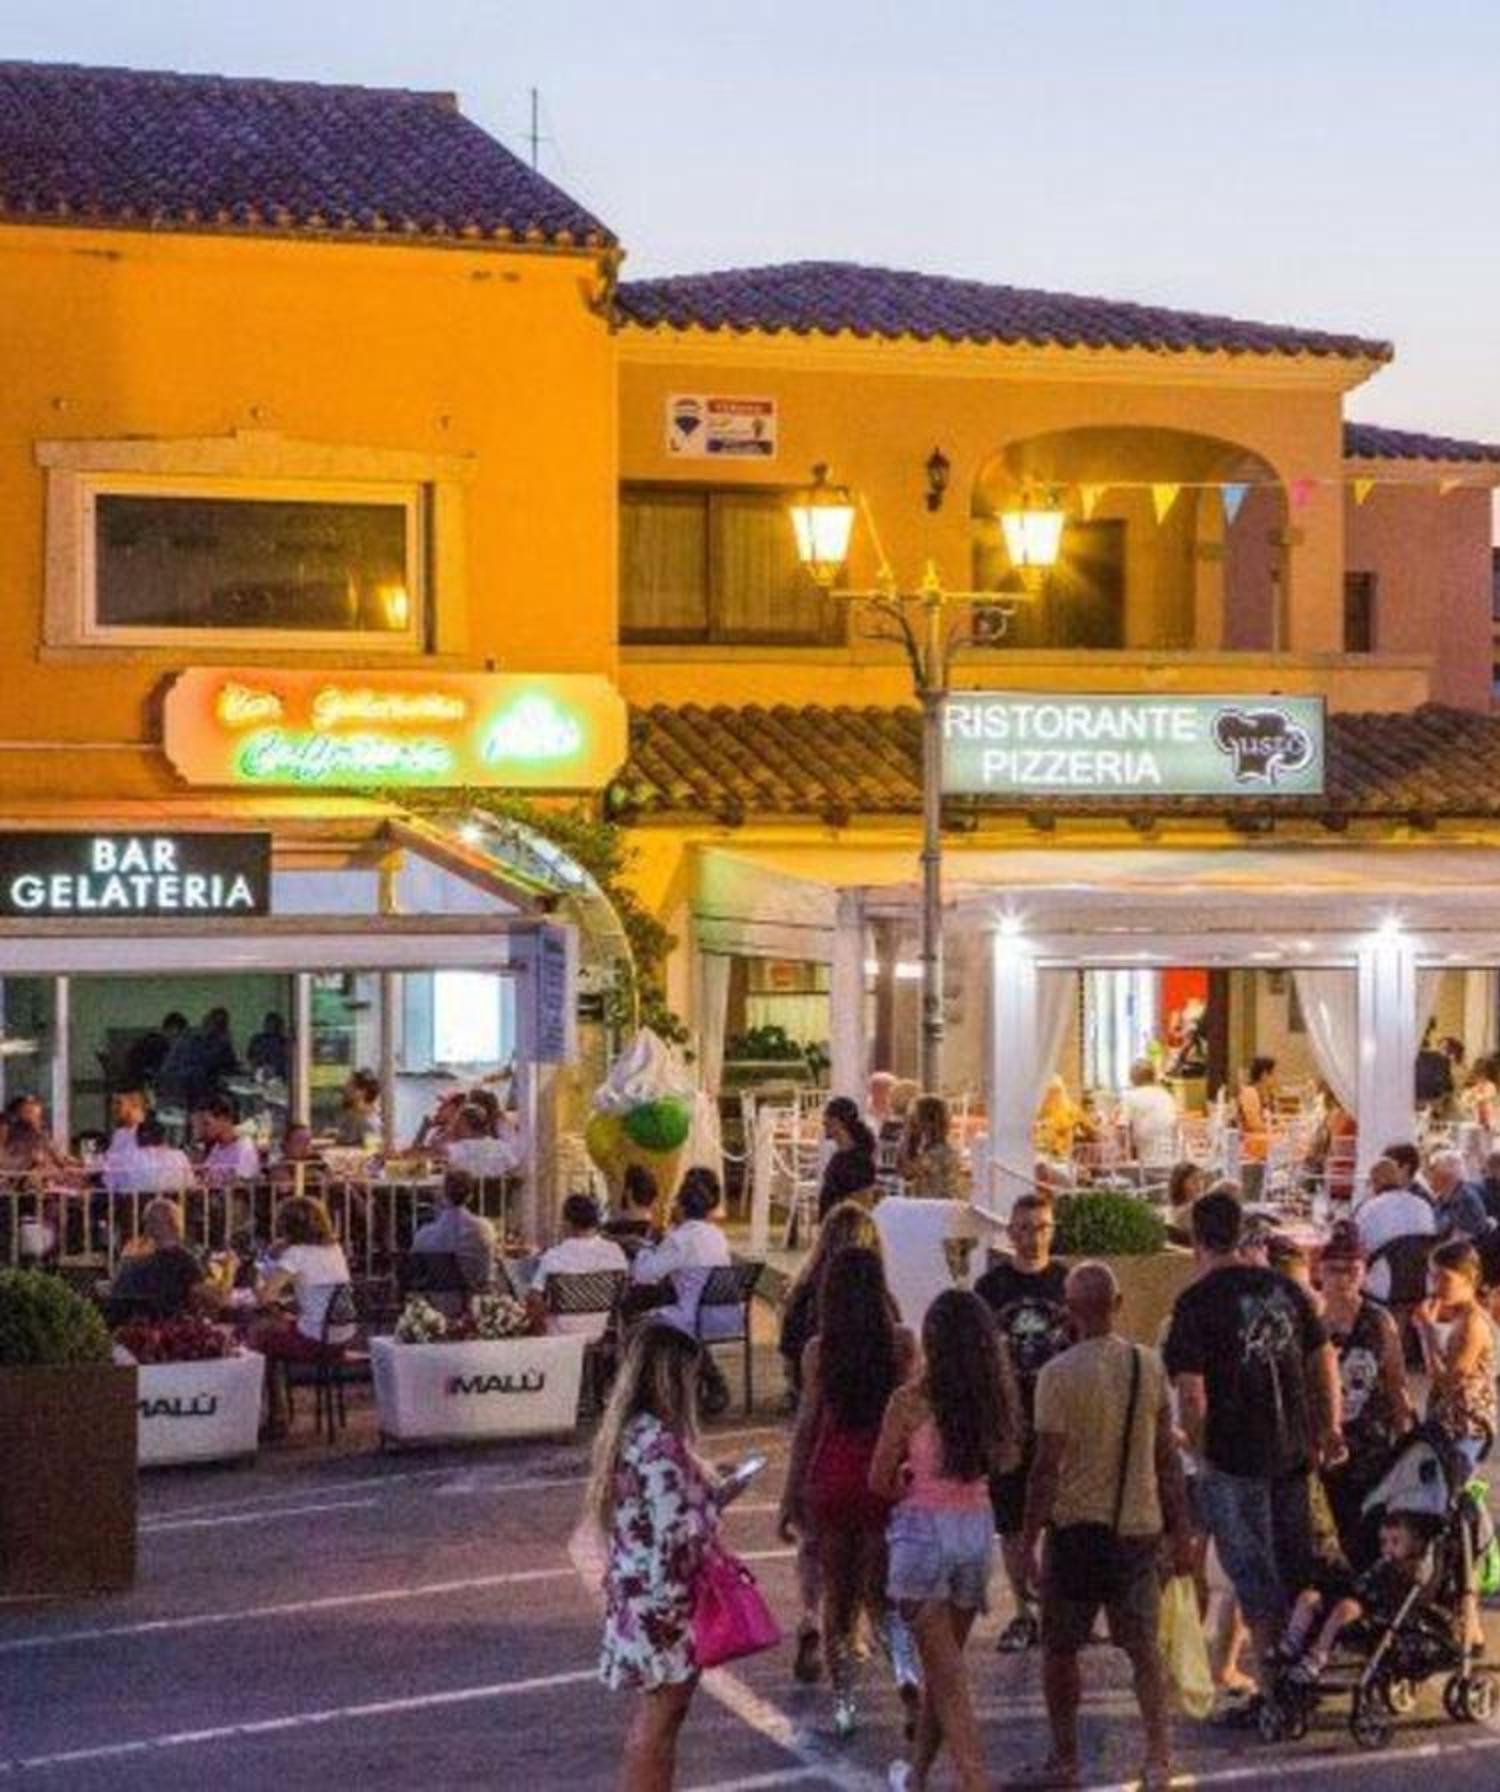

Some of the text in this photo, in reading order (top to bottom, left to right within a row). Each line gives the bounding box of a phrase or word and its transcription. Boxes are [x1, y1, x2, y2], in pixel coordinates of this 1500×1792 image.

[944, 703, 1199, 741] RISTORANTE
[982, 751, 1163, 785] PIZZERIA
[92, 838, 178, 873] BAR
[10, 874, 255, 910] GELATERIA
